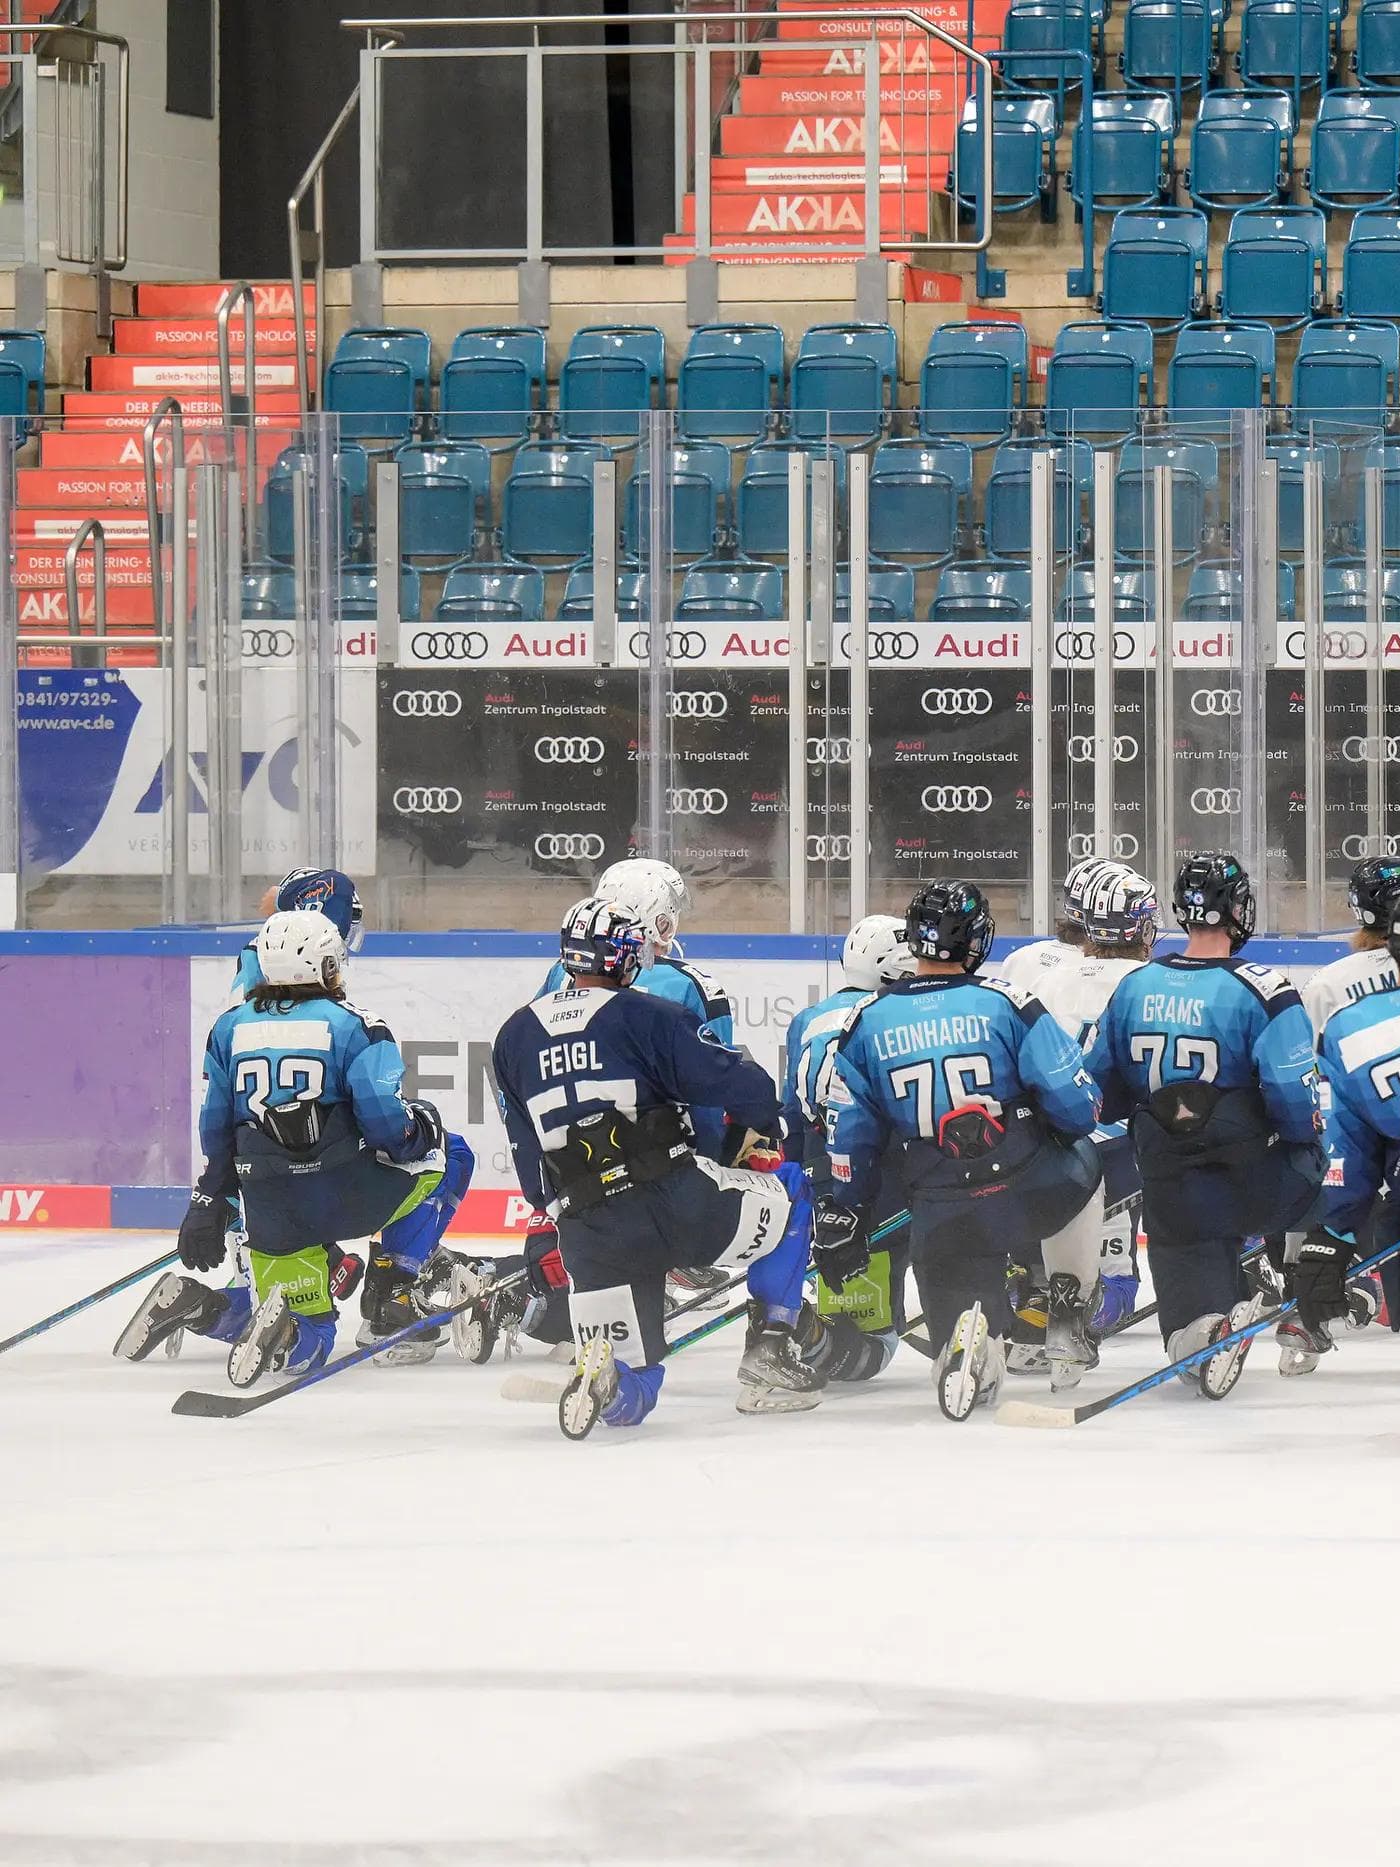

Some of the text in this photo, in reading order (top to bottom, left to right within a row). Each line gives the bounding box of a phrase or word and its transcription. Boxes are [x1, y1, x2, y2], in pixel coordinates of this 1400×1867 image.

[781, 90, 828, 102] PASSION
[831, 90, 853, 101] FOR
[155, 331, 202, 342] PASSION
[126, 401, 149, 413] DER
[57, 481, 131, 493] PASSION FOR
[29, 557, 53, 568] DER
[503, 632, 587, 658] Audi
[934, 632, 1020, 659] Audi
[751, 694, 781, 704] Audi
[484, 704, 607, 716] Zentrum Ingolstadt
[750, 706, 790, 715] Zentru
[1073, 702, 1141, 715] Ingtadt
[895, 740, 926, 750] Audi
[684, 750, 750, 762] Ingolstadt
[894, 751, 1019, 763] Zentrum Ingolstadt
[1172, 750, 1214, 760] entrum
[485, 801, 607, 813] Zentrum Ingolstadt
[750, 803, 790, 812] Zentru
[1073, 801, 1141, 813] Ingtadt
[895, 838, 926, 847] Audi
[894, 848, 1019, 861] Zentrum Ingolstadt
[1188, 906, 1204, 921] 72
[920, 940, 936, 956] 76
[553, 989, 591, 1001] ERC
[1142, 993, 1205, 1027] GRAMS
[874, 1014, 992, 1061] LEONHARDT
[538, 1040, 603, 1082] FEIGL
[827, 1292, 874, 1307] ziegler
